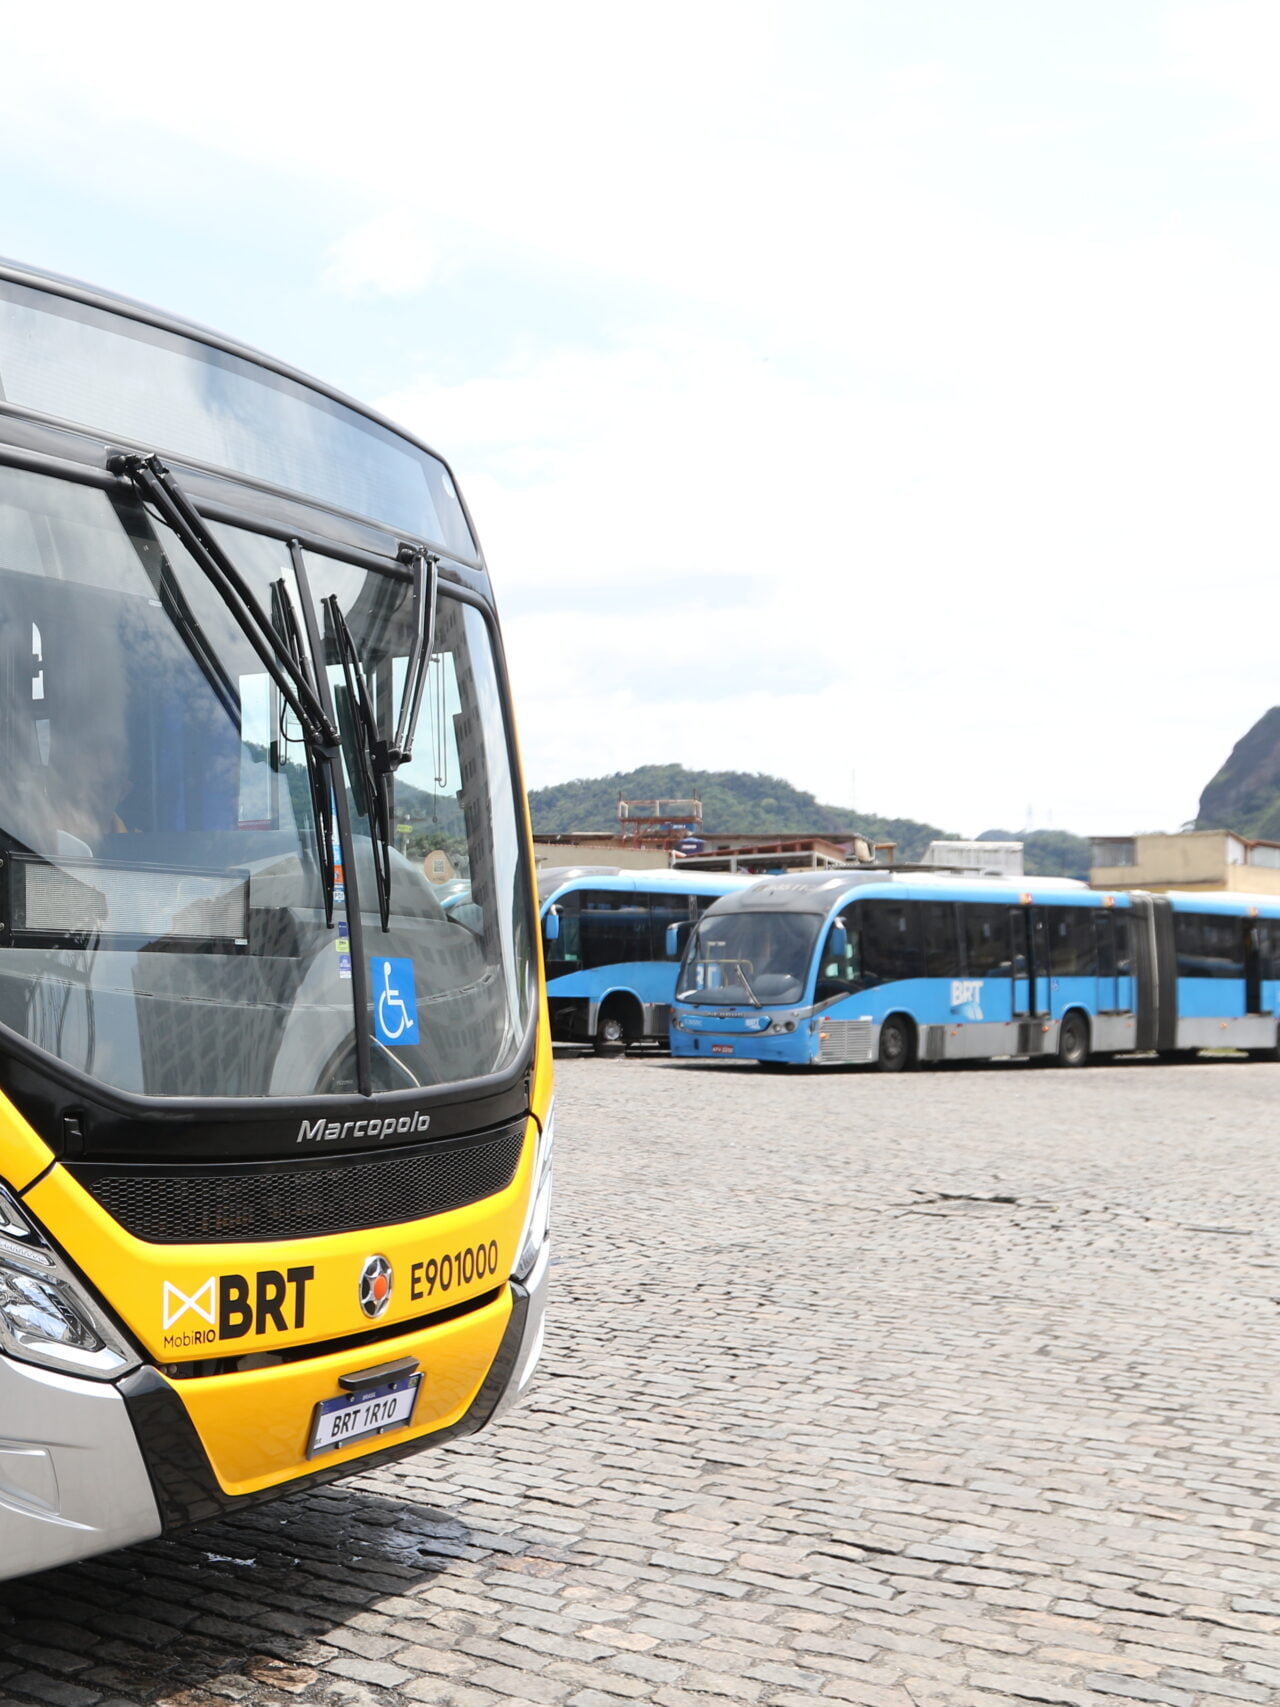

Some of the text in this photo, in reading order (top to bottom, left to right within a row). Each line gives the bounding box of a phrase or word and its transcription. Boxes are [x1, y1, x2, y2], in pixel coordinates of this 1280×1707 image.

[951, 980, 984, 1006] BRT
[296, 1111, 431, 1143] Marcopolo
[219, 1239, 499, 1341] BRT E901000
[163, 1329, 217, 1349] MobiRIO
[331, 1397, 398, 1438] BRT 1R10
